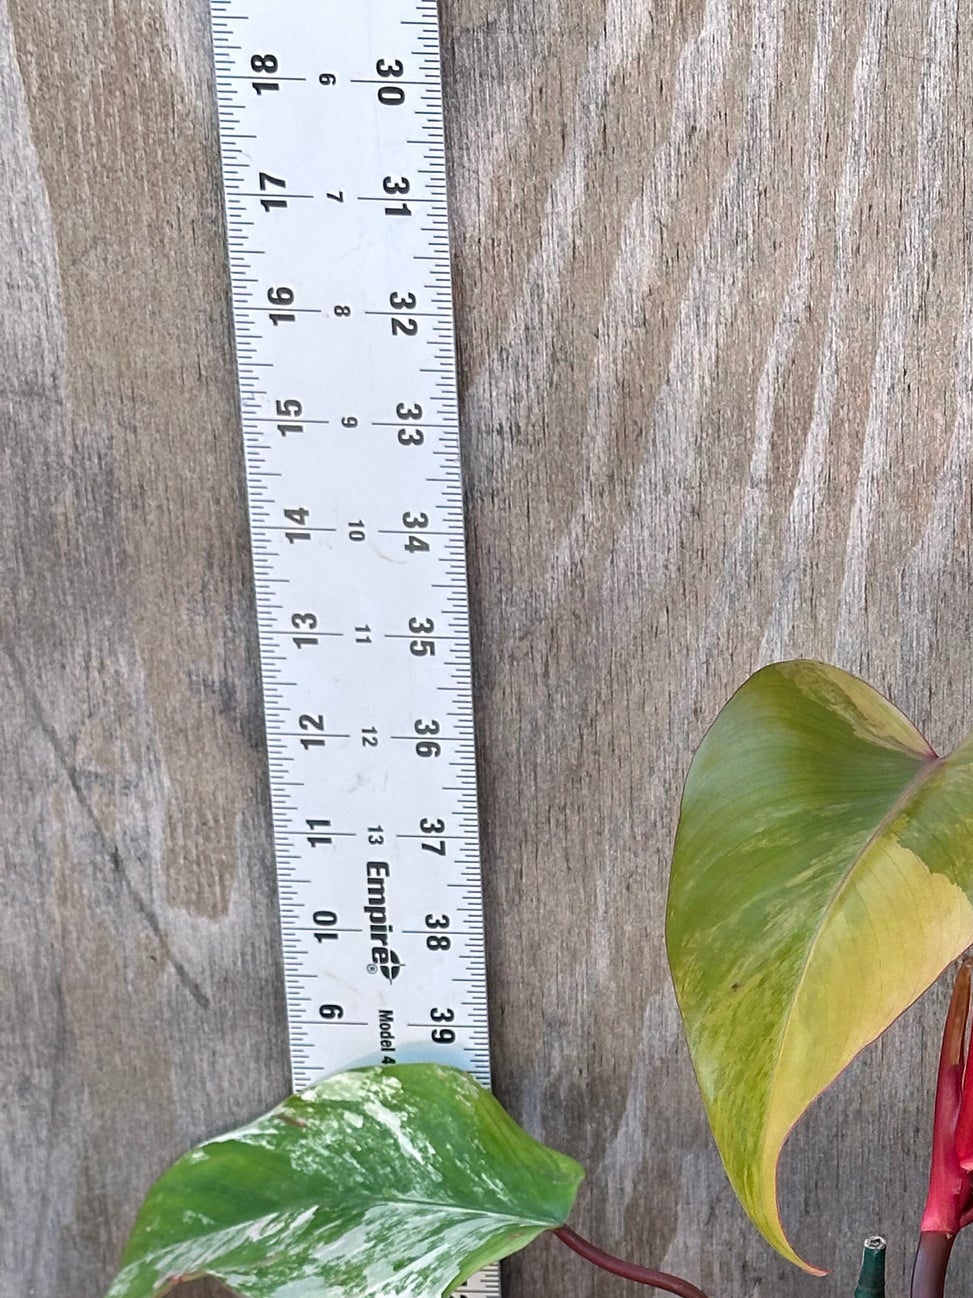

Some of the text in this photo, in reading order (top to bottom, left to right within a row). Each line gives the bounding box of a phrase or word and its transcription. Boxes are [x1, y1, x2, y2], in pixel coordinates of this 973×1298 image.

[250, 54, 280, 95] 18
[318, 73, 337, 86] 6
[376, 58, 406, 106] 30
[259, 172, 288, 212] 17
[326, 191, 344, 203] 7
[382, 176, 412, 216] 31
[267, 286, 296, 326] 16
[333, 305, 351, 317] 8
[389, 291, 418, 336] 32
[276, 399, 304, 437] 15
[341, 416, 358, 428] 9
[396, 402, 424, 446] 33
[283, 507, 311, 544] 14
[348, 519, 366, 542] 10
[402, 511, 430, 553] 34
[291, 612, 319, 649] 13
[355, 624, 372, 644] 11
[408, 617, 436, 657] 35
[298, 714, 326, 751] 12
[361, 726, 379, 747] 12
[414, 719, 441, 758] 36
[305, 819, 333, 848] 11
[367, 825, 384, 846] 13
[419, 818, 446, 856] 37
[312, 910, 338, 943] 10
[363, 861, 394, 965] Empire
[424, 914, 451, 951] 38
[319, 1004, 344, 1019] 9
[430, 1007, 456, 1044] 39
[379, 1010, 396, 1051] Model
